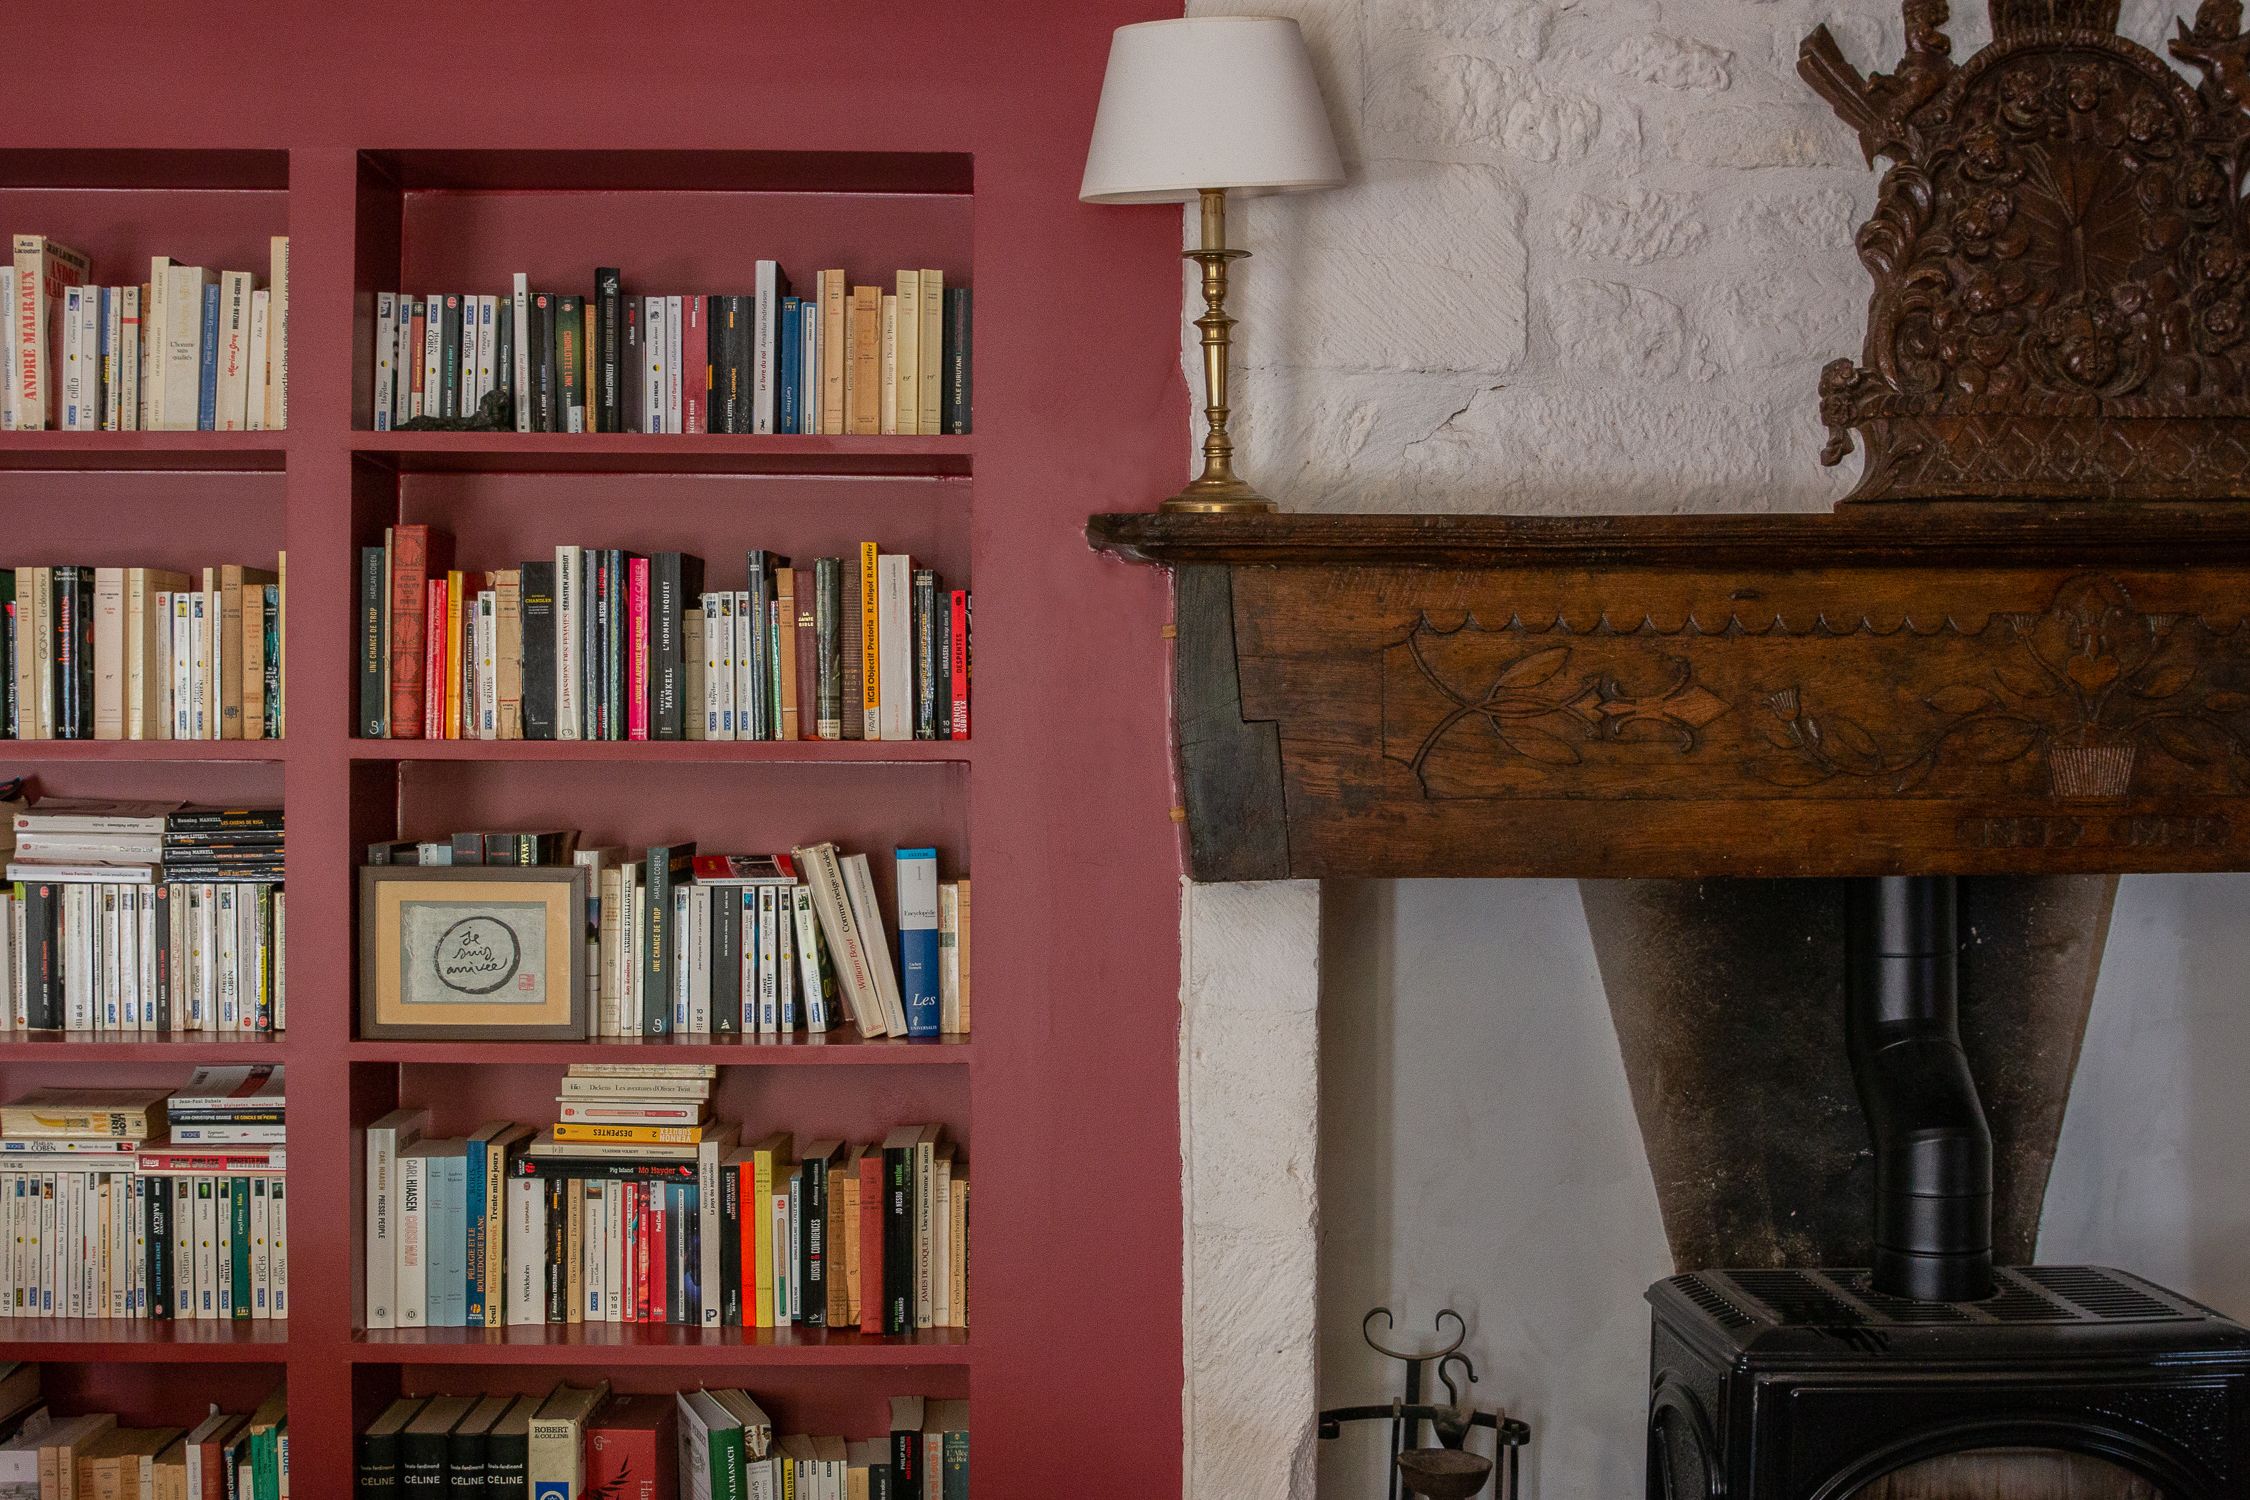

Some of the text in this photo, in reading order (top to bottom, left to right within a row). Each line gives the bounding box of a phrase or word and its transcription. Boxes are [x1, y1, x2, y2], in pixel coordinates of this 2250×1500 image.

[22, 271, 36, 401] ANDRÉ MALRAUX
[464, 330, 472, 358] PATTERSON
[225, 333, 240, 376] Marina Grey
[760, 360, 767, 368] du
[70, 378, 79, 399] CHILD
[605, 387, 614, 407] Michael
[867, 544, 875, 571] Kauffer
[562, 554, 570, 611] SÉBASTIEN JAPRISOT
[368, 554, 377, 673] UNE CHANCE DE TROP HARLAN COBEN
[39, 625, 48, 660] GIONO
[562, 613, 570, 646] FEMMES
[867, 619, 875, 650] Pretoria
[562, 646, 570, 662] DES
[867, 652, 875, 684] Objectif
[562, 663, 570, 701] PASSION
[665, 667, 673, 708] MANKELL
[867, 686, 875, 703] KGB
[867, 709, 876, 732] FAVRE
[827, 868, 835, 878] au
[829, 879, 843, 900] neige
[652, 855, 661, 972] UNE CHANCE DE TROP HARLAN COBEN
[836, 901, 851, 932] Comme
[446, 957, 508, 975] arrivée
[846, 938, 867, 990] William Boyd
[912, 994, 936, 1006] Les
[593, 1128, 633, 1137] DESPENTES
[406, 1159, 418, 1179] CARL
[638, 1166, 650, 1174] Mo
[651, 1166, 676, 1176] Hayder
[894, 1164, 903, 1186] FANTÔME
[406, 1179, 418, 1212] HIAASEN
[490, 1152, 498, 1324] Seuil Maurice Genevoix Trente mille jours
[810, 1219, 820, 1254] CONFIDENCES
[467, 1228, 475, 1280] PÉLAGIE ET LE
[476, 1216, 484, 1292] BOULEDOGUE BLANC
[181, 1252, 190, 1284] Chattam
[258, 1256, 267, 1282] REICHS
[810, 1260, 820, 1280] CUISINE
[922, 1268, 929, 1278] DE
[226, 1456, 234, 1490] chansons
[360, 1474, 395, 1486] CÉLINE
[404, 1474, 440, 1484] CÉLINE
[450, 1474, 485, 1486] CÉLINE
[488, 1474, 523, 1484] CÉLINE
[727, 1446, 736, 1494] ALMANACH
